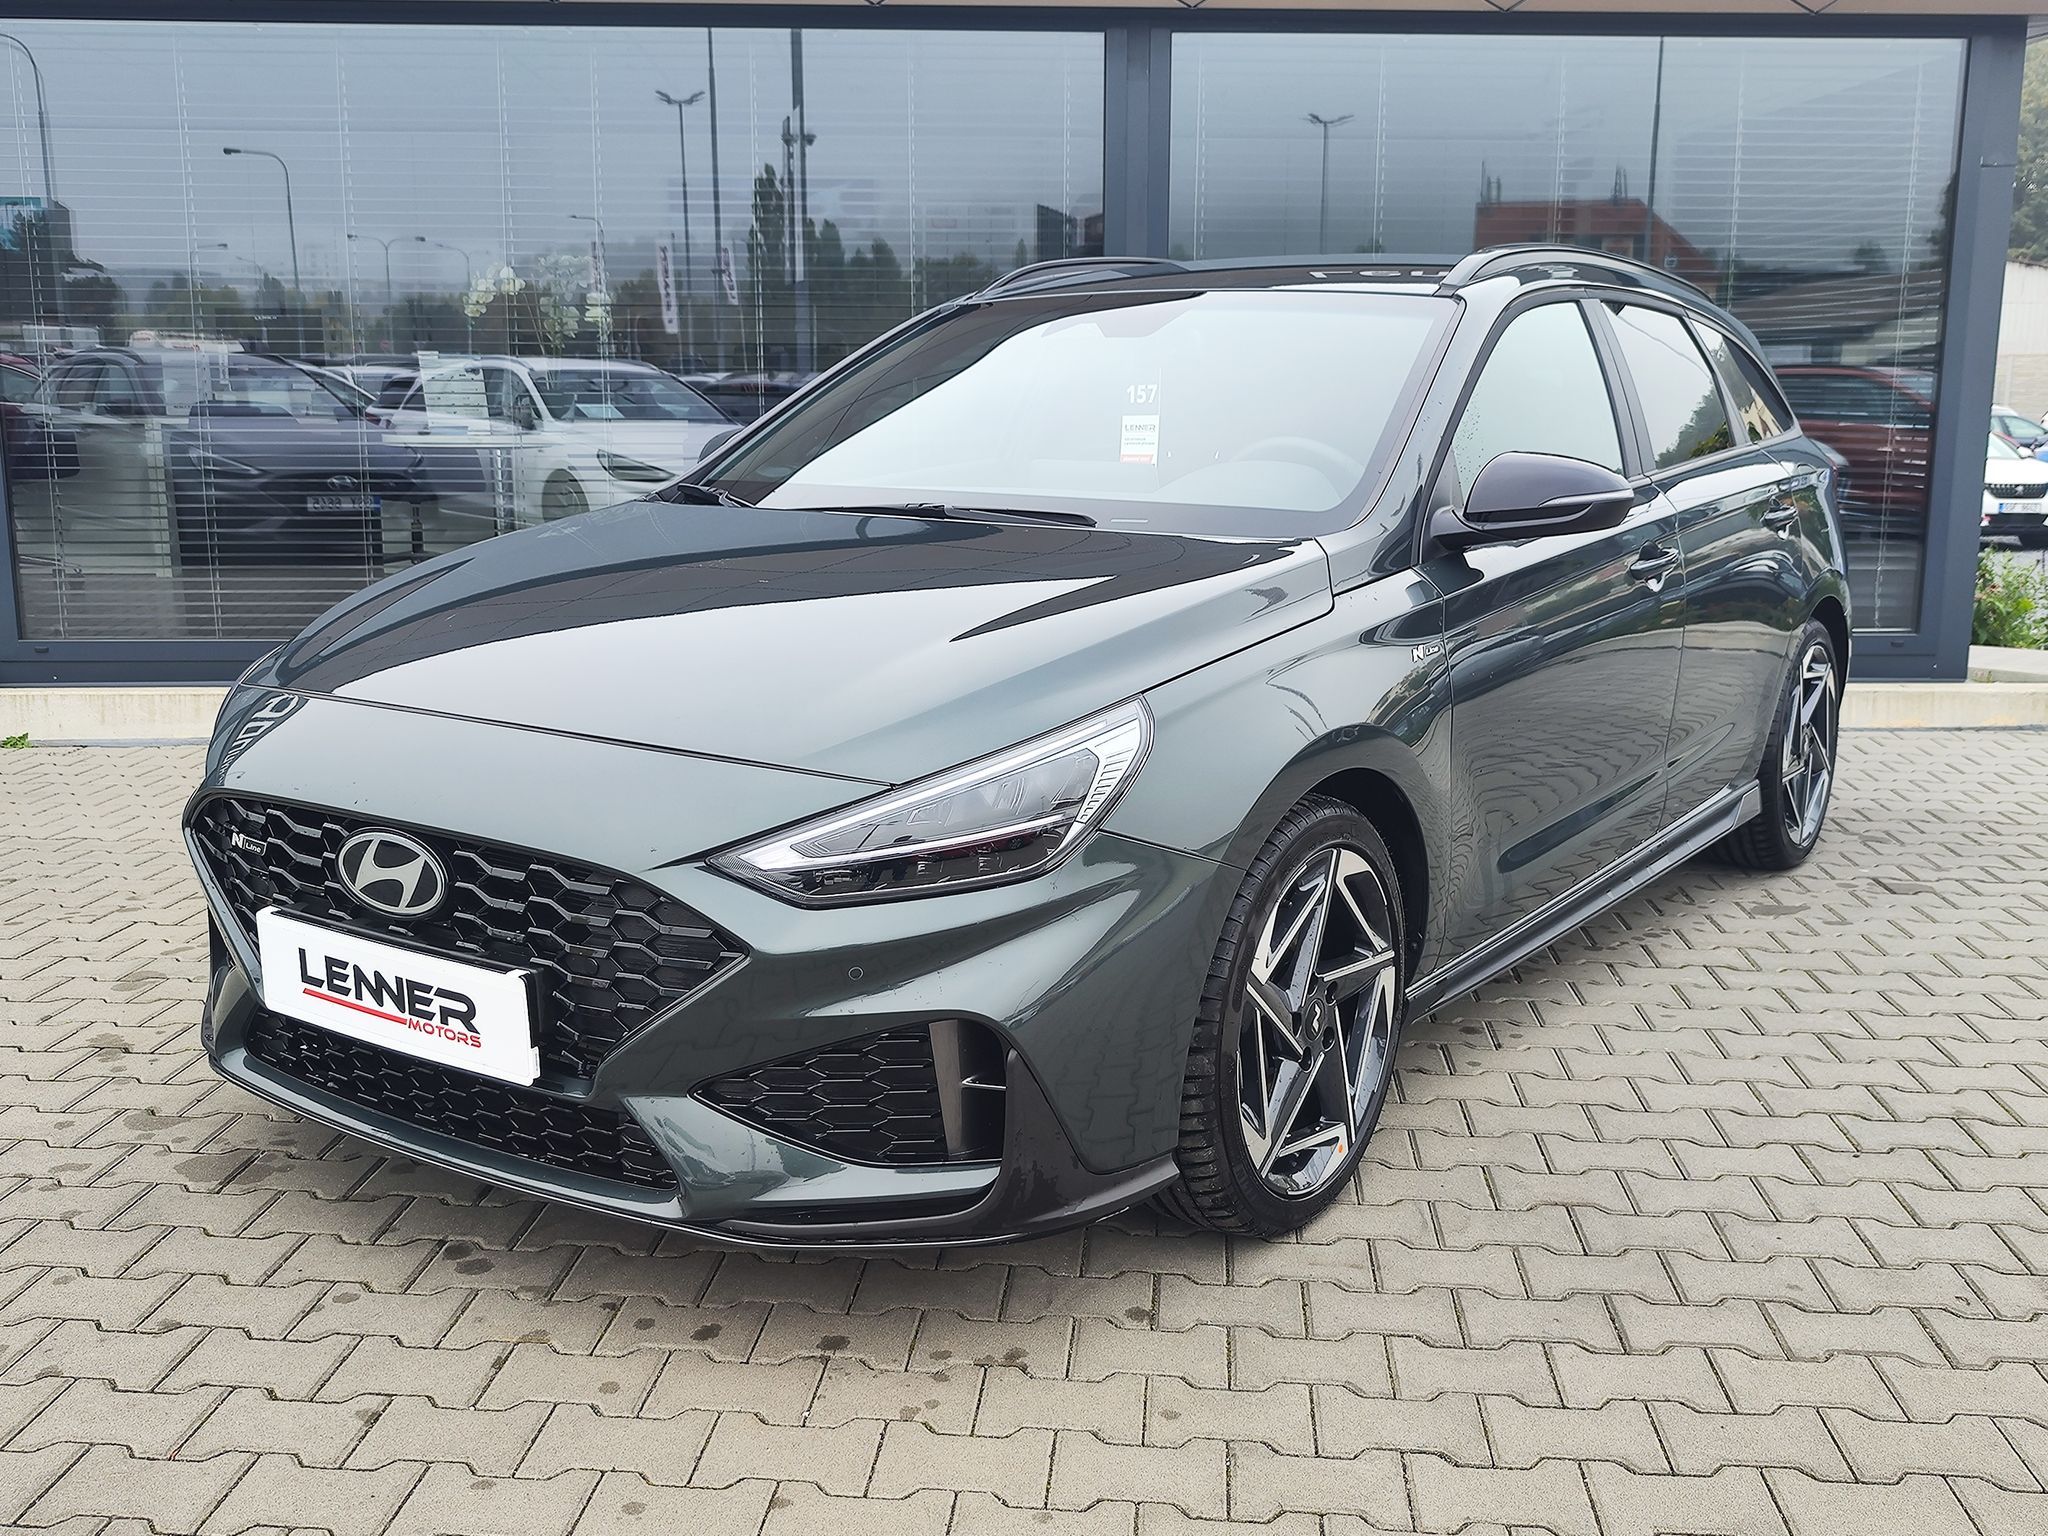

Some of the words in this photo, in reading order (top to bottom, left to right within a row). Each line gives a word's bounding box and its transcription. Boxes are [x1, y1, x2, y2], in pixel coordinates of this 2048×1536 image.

[1127, 384, 1158, 404] 157
[232, 832, 244, 848] N
[298, 947, 481, 1035] LENNER
[408, 1017, 482, 1049] MOTORS
